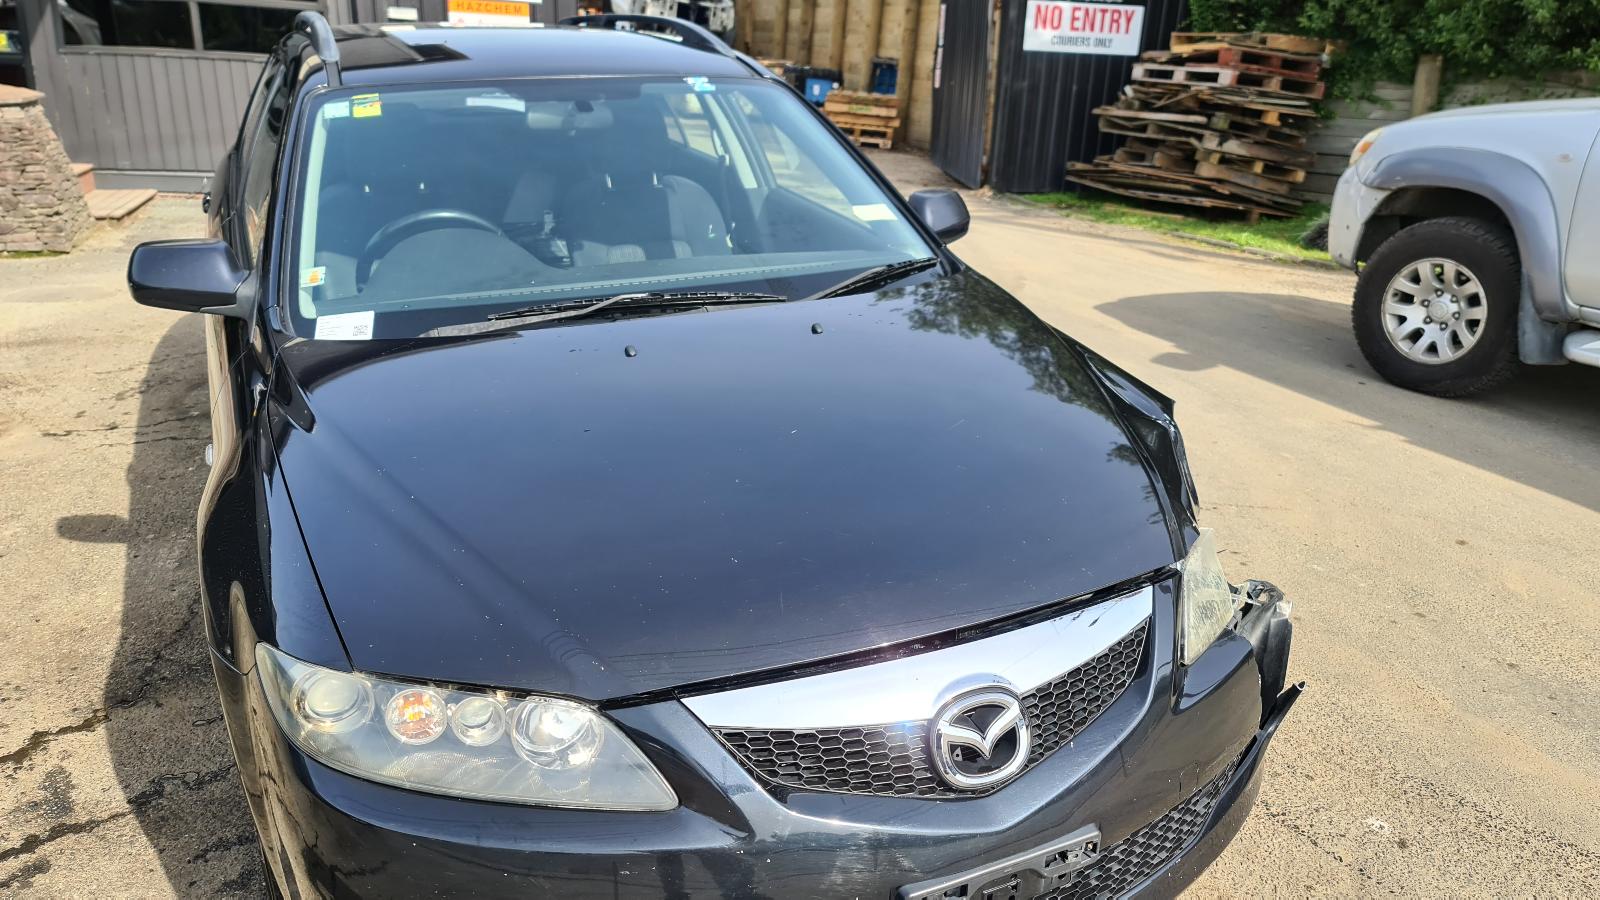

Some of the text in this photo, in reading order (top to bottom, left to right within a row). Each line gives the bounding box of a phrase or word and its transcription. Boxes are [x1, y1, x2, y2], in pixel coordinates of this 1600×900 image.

[456, 2, 522, 15] HAZCHEM
[1034, 4, 1136, 34] NO ENTRY
[1051, 35, 1113, 48] COURIERS ONLY
